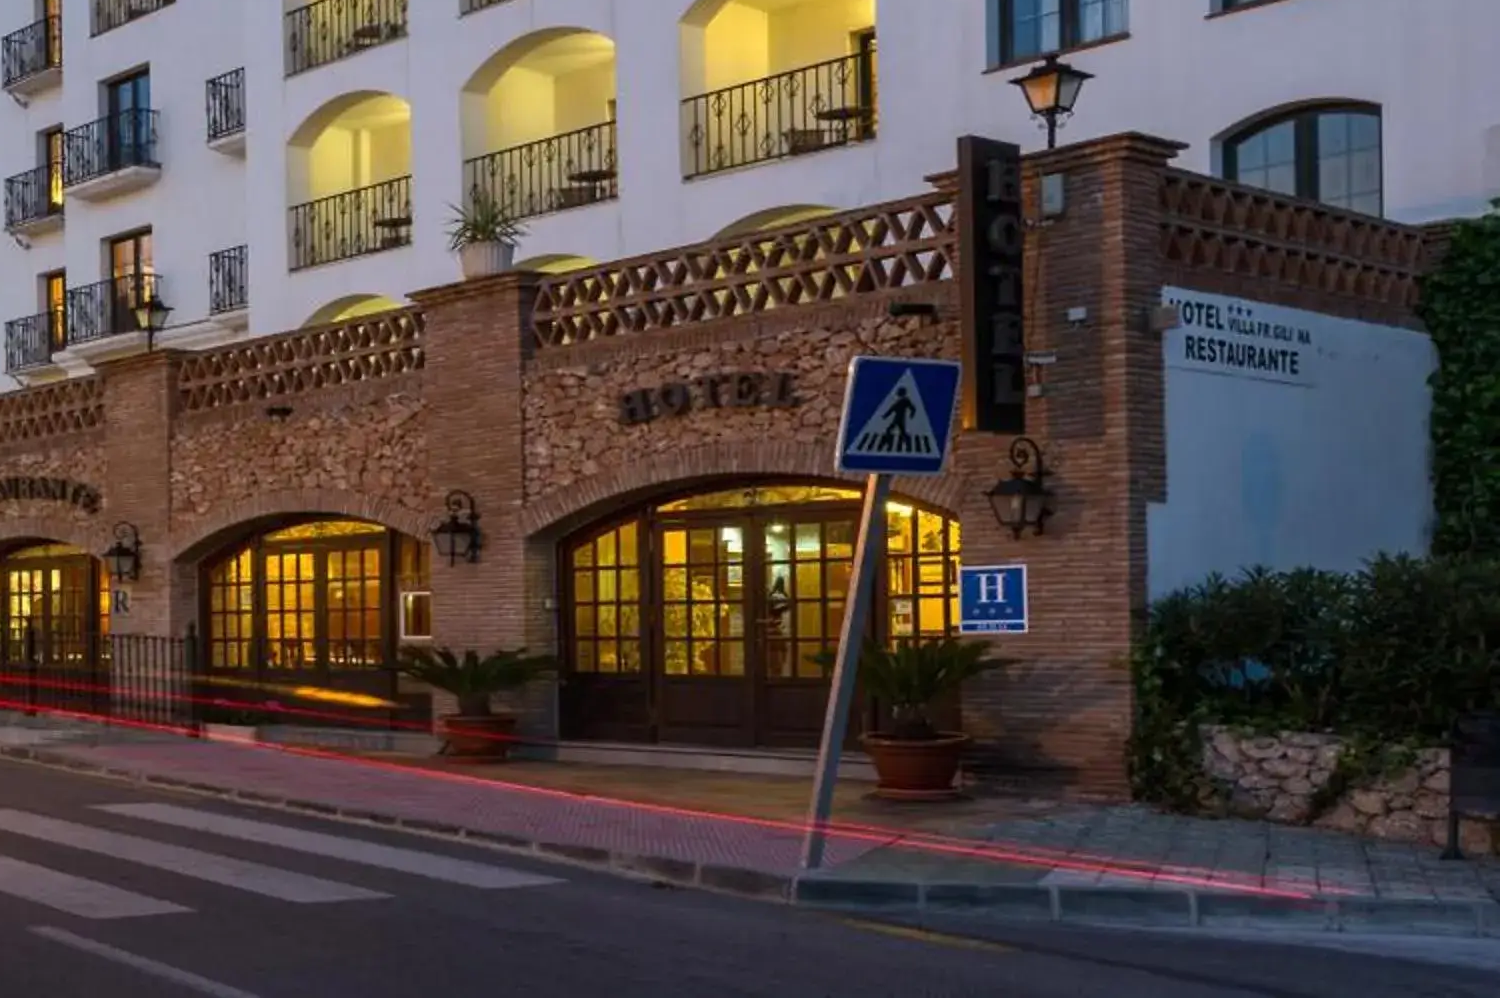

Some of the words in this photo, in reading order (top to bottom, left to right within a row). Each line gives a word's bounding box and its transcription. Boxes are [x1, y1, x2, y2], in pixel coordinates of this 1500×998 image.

[1169, 298, 1224, 330] OTEL
[1185, 335, 1299, 375] RESTAURANTE
[619, 371, 803, 425] HOTEL
[114, 590, 129, 612] R
[977, 573, 1007, 603] H
